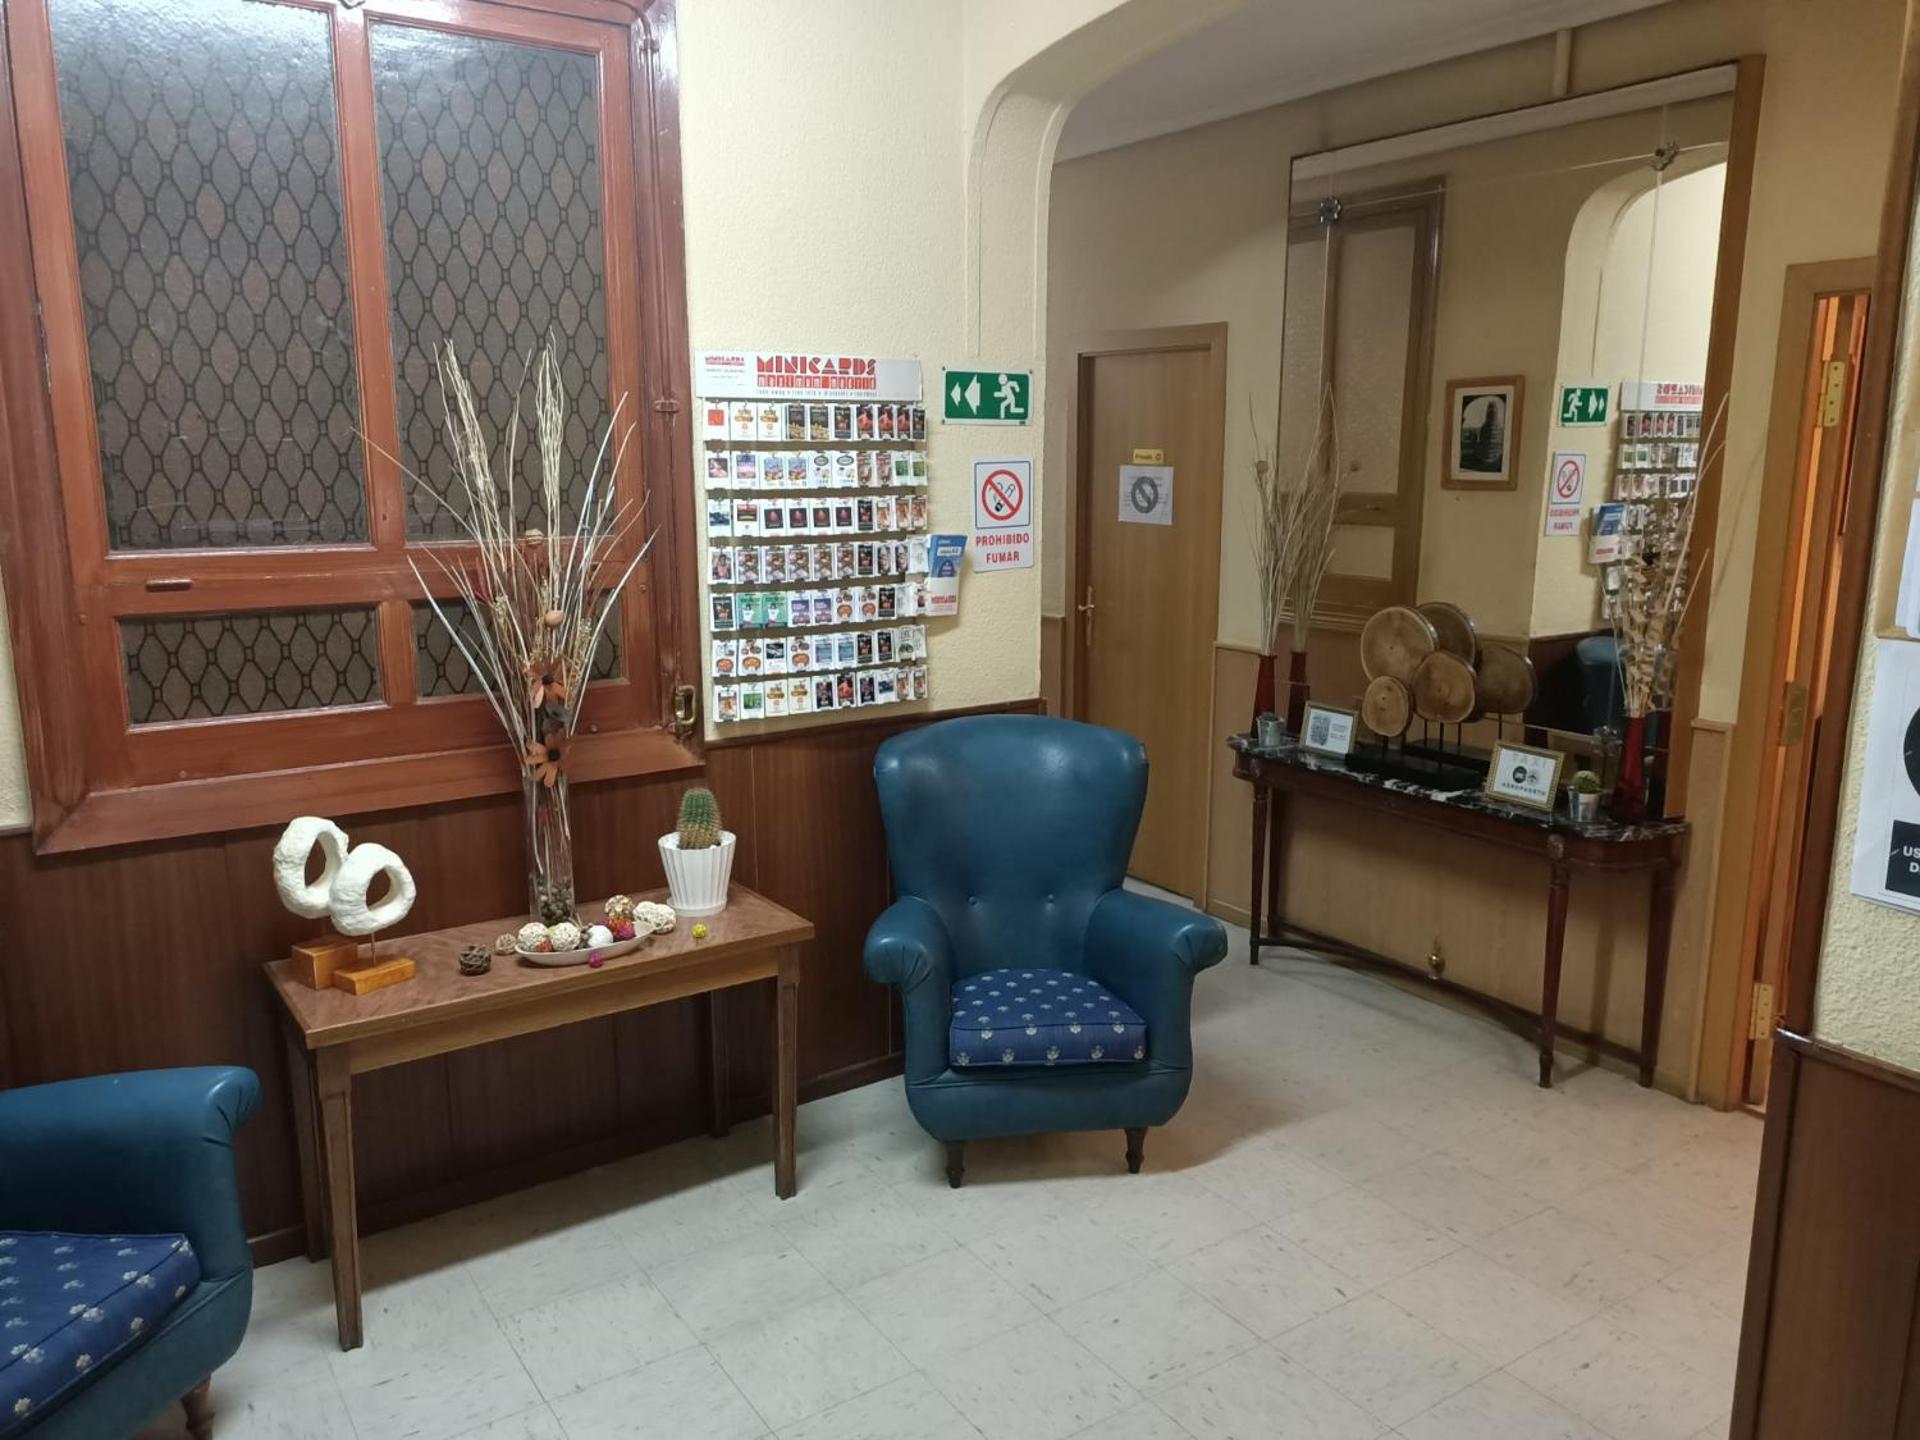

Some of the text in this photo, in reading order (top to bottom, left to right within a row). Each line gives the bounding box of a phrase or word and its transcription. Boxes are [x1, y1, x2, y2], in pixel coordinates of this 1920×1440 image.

[756, 355, 877, 375] MINICARDS
[975, 532, 1030, 547] PROHIBIDO
[985, 550, 1020, 564] FUMAR
